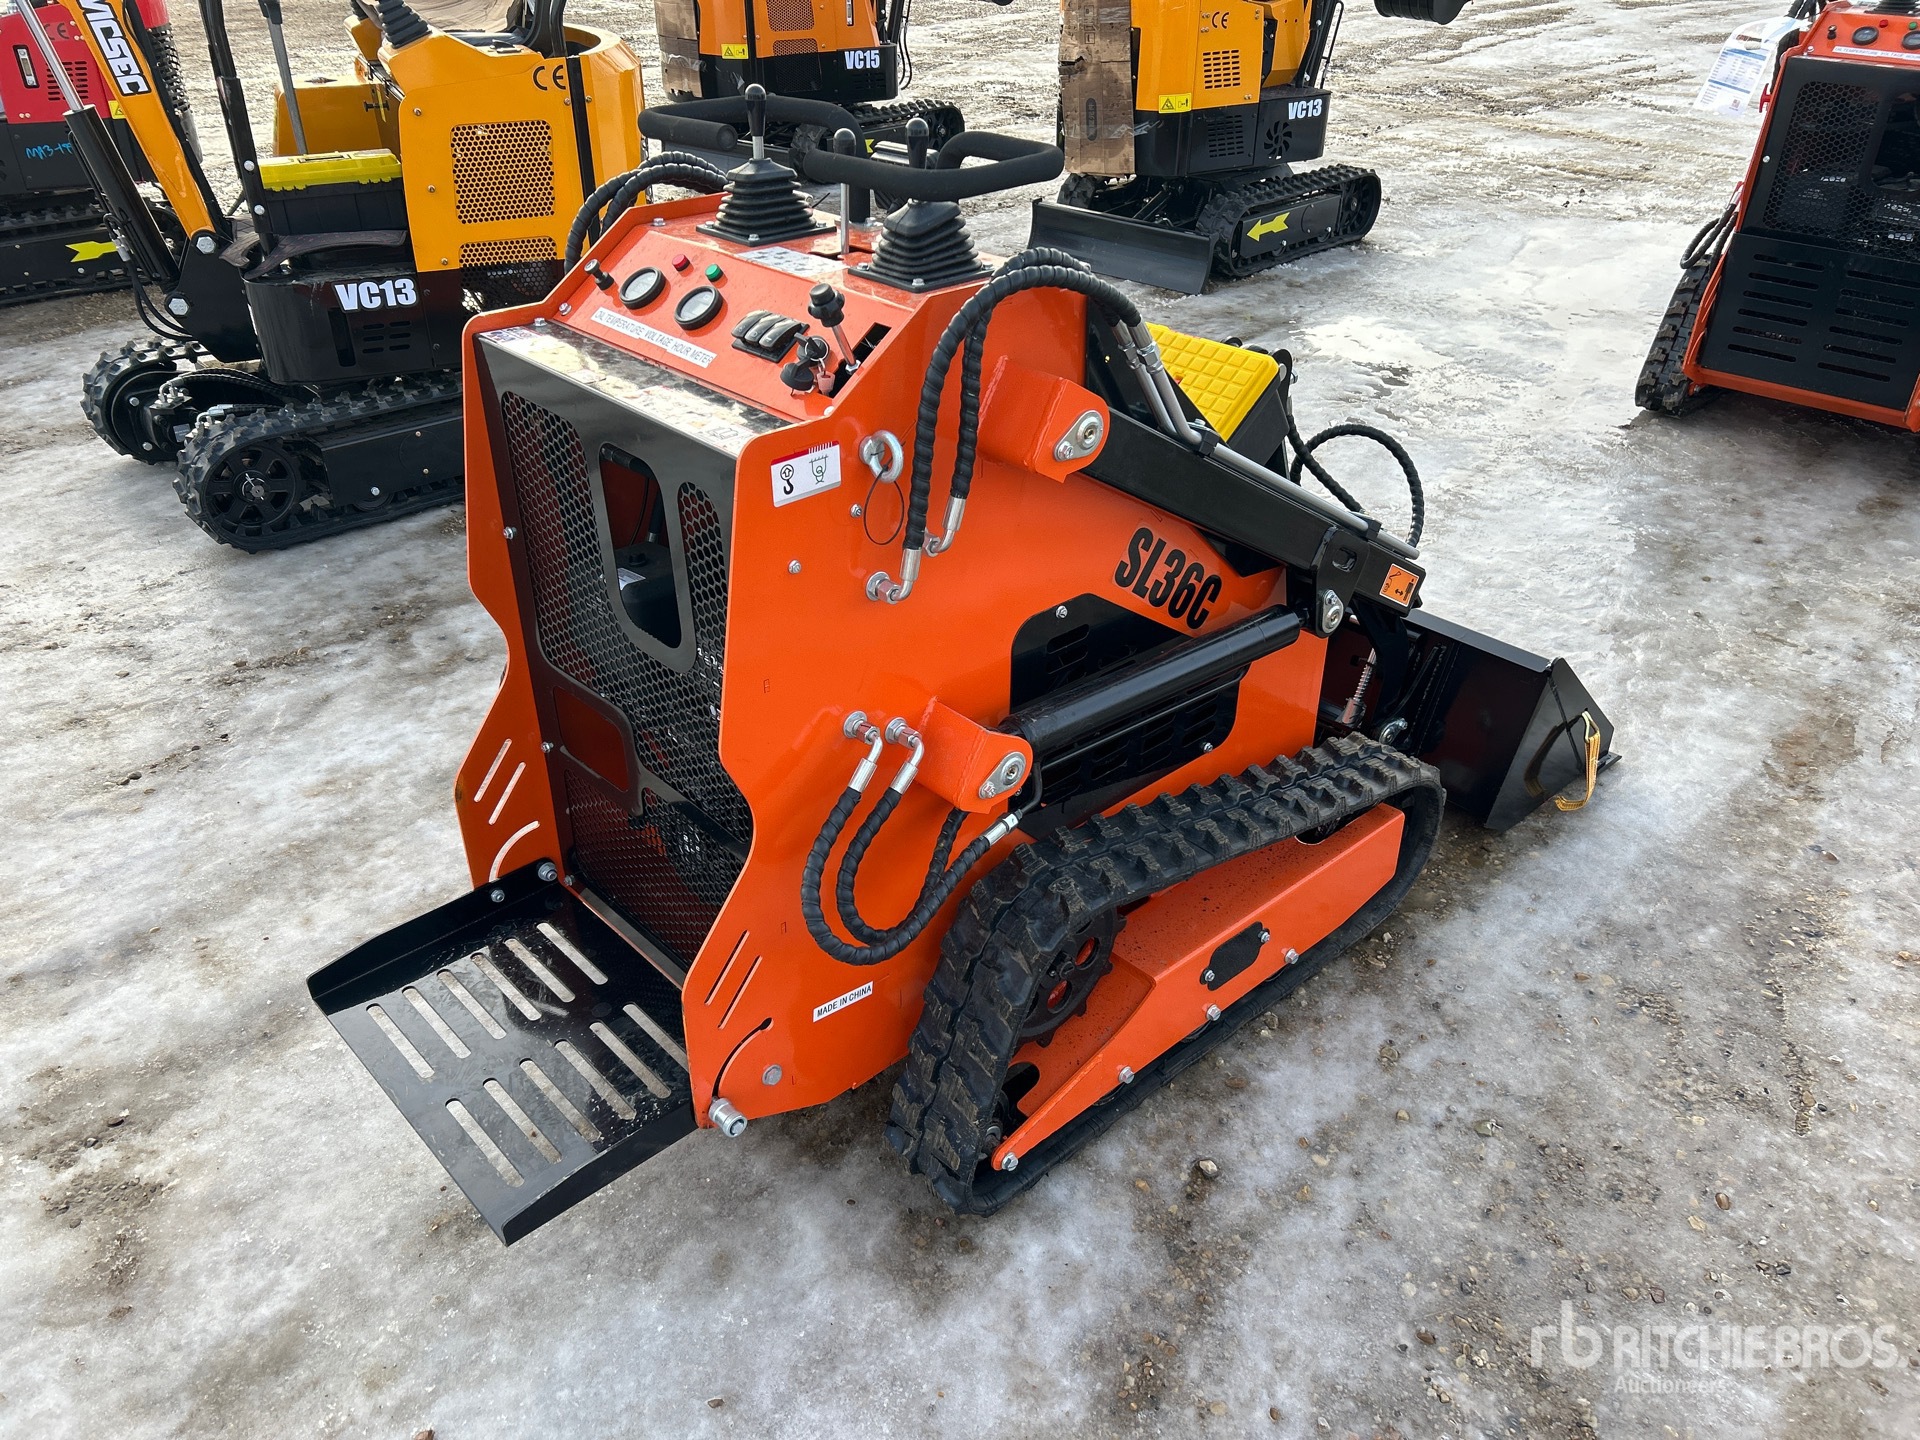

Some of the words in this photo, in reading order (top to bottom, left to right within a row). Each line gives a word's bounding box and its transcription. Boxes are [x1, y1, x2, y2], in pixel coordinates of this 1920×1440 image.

[844, 50, 880, 69] VC15
[1288, 98, 1323, 120] VC13
[334, 278, 417, 311] VC13
[605, 313, 645, 336] TEMPERATURE
[644, 328, 673, 347] VOLTAGE
[672, 339, 693, 356] HOUR
[1114, 527, 1223, 630] SL36C
[817, 1000, 838, 1017] MADE
[839, 996, 848, 1006] IN
[848, 985, 872, 1001] CHINA
